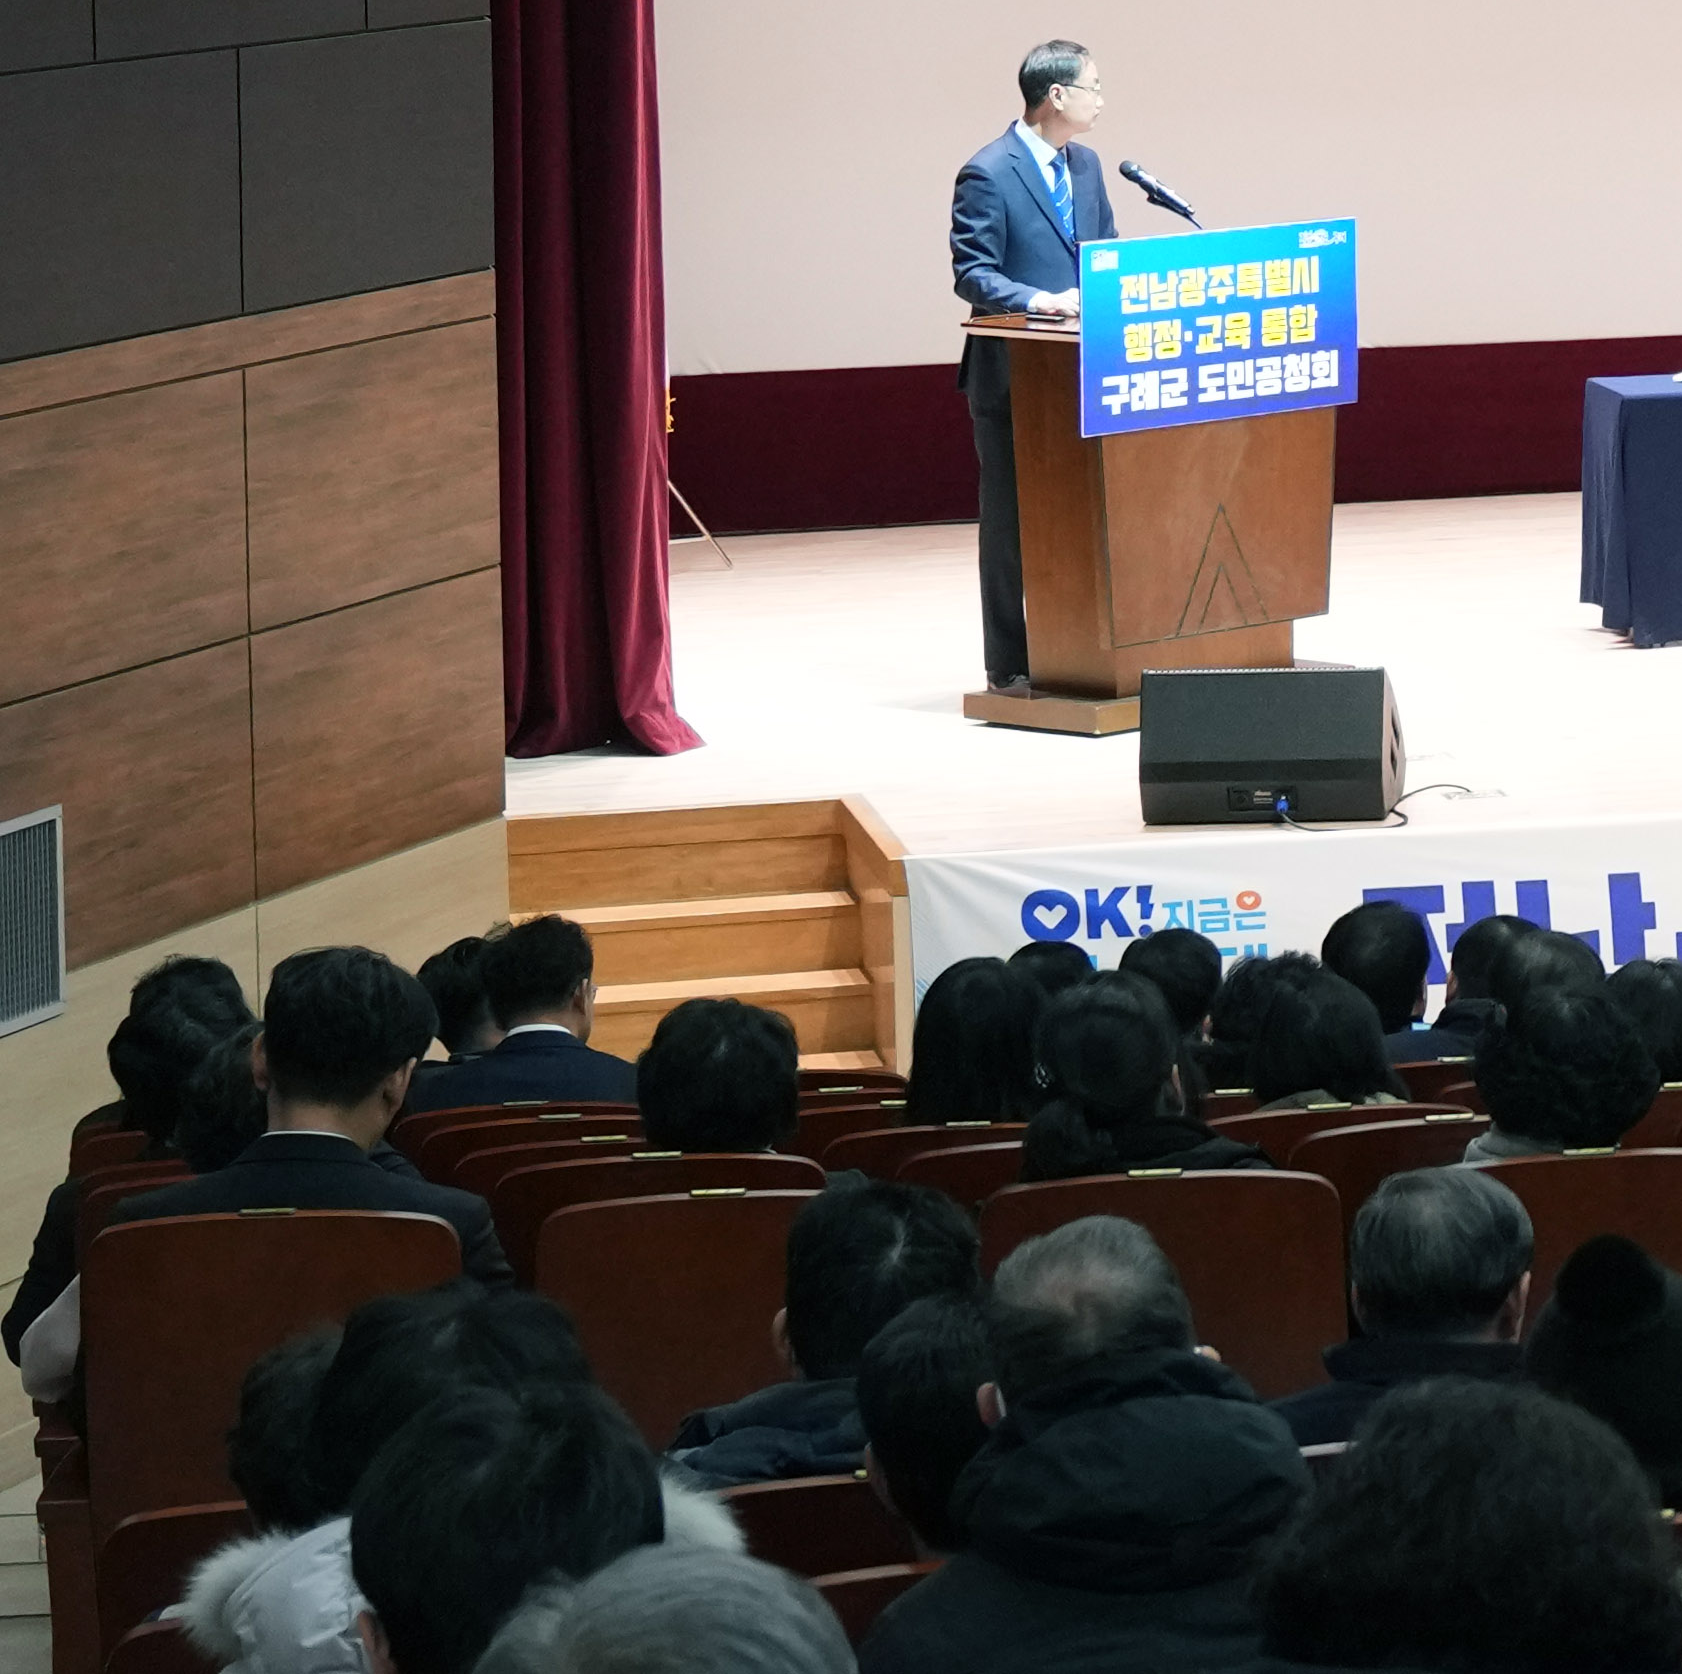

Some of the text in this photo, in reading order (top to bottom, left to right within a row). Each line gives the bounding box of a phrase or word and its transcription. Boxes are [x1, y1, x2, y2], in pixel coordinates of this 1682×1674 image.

[1119, 255, 1320, 314] 전남광주특별시
[1123, 303, 1318, 363] 행정·교육 통합
[1101, 349, 1339, 415] 구례군 도민공청회
[1020, 884, 1267, 942] OK! 지금은
